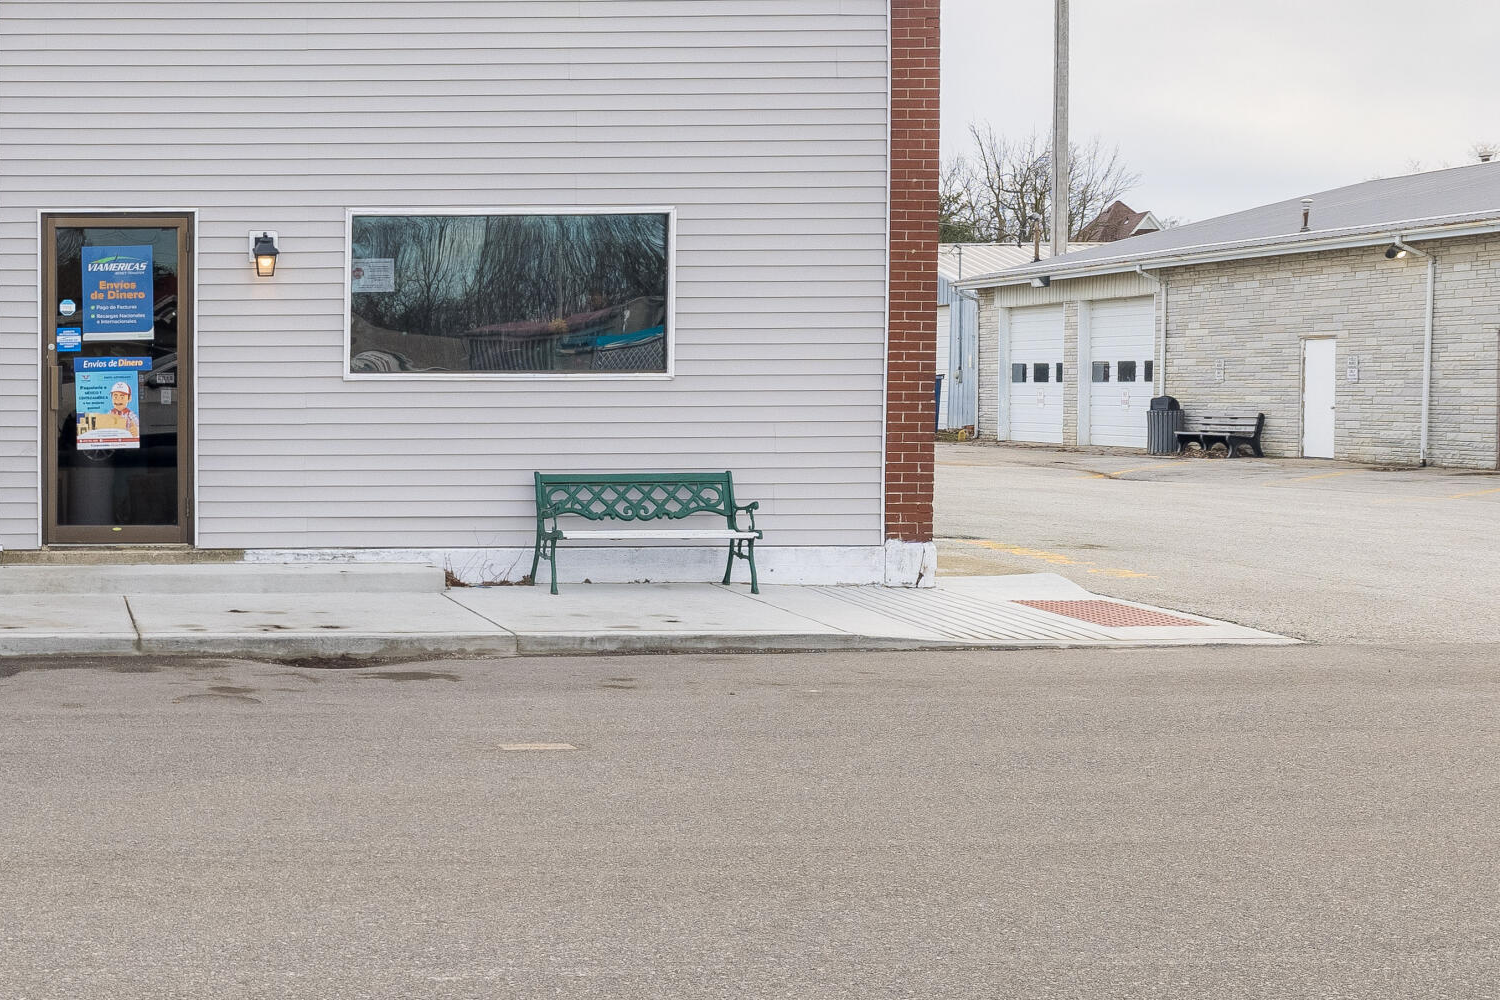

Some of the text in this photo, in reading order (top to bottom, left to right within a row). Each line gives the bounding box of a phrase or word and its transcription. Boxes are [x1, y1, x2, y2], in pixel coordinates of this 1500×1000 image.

[88, 262, 147, 271] VIAMERICAS
[90, 290, 145, 299] de Dinero
[108, 359, 117, 367] de
[118, 359, 143, 367] Dinero
